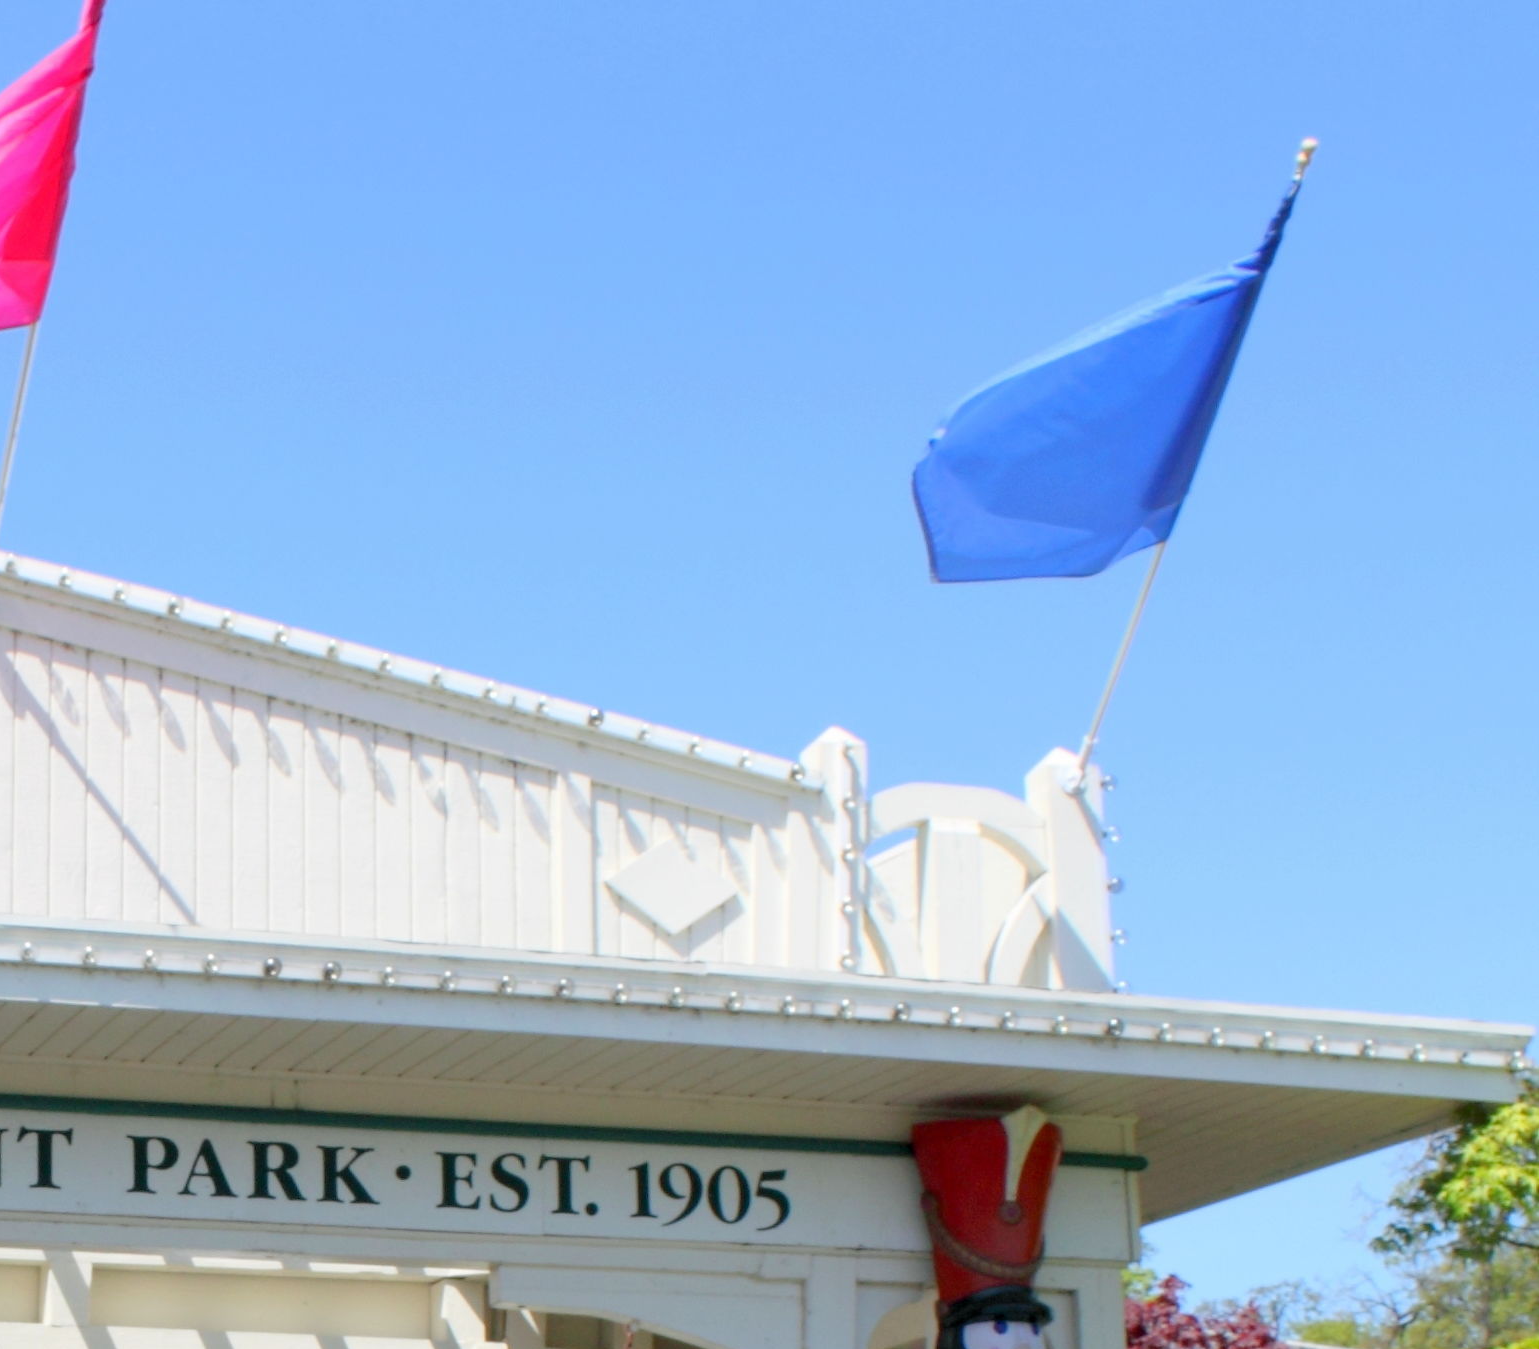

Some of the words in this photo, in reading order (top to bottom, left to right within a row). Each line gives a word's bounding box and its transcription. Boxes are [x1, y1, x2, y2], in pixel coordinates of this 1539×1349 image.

[125, 1134, 380, 1206] PARK
[434, 1150, 600, 1217] EST.
[627, 1160, 792, 1232] 1905
